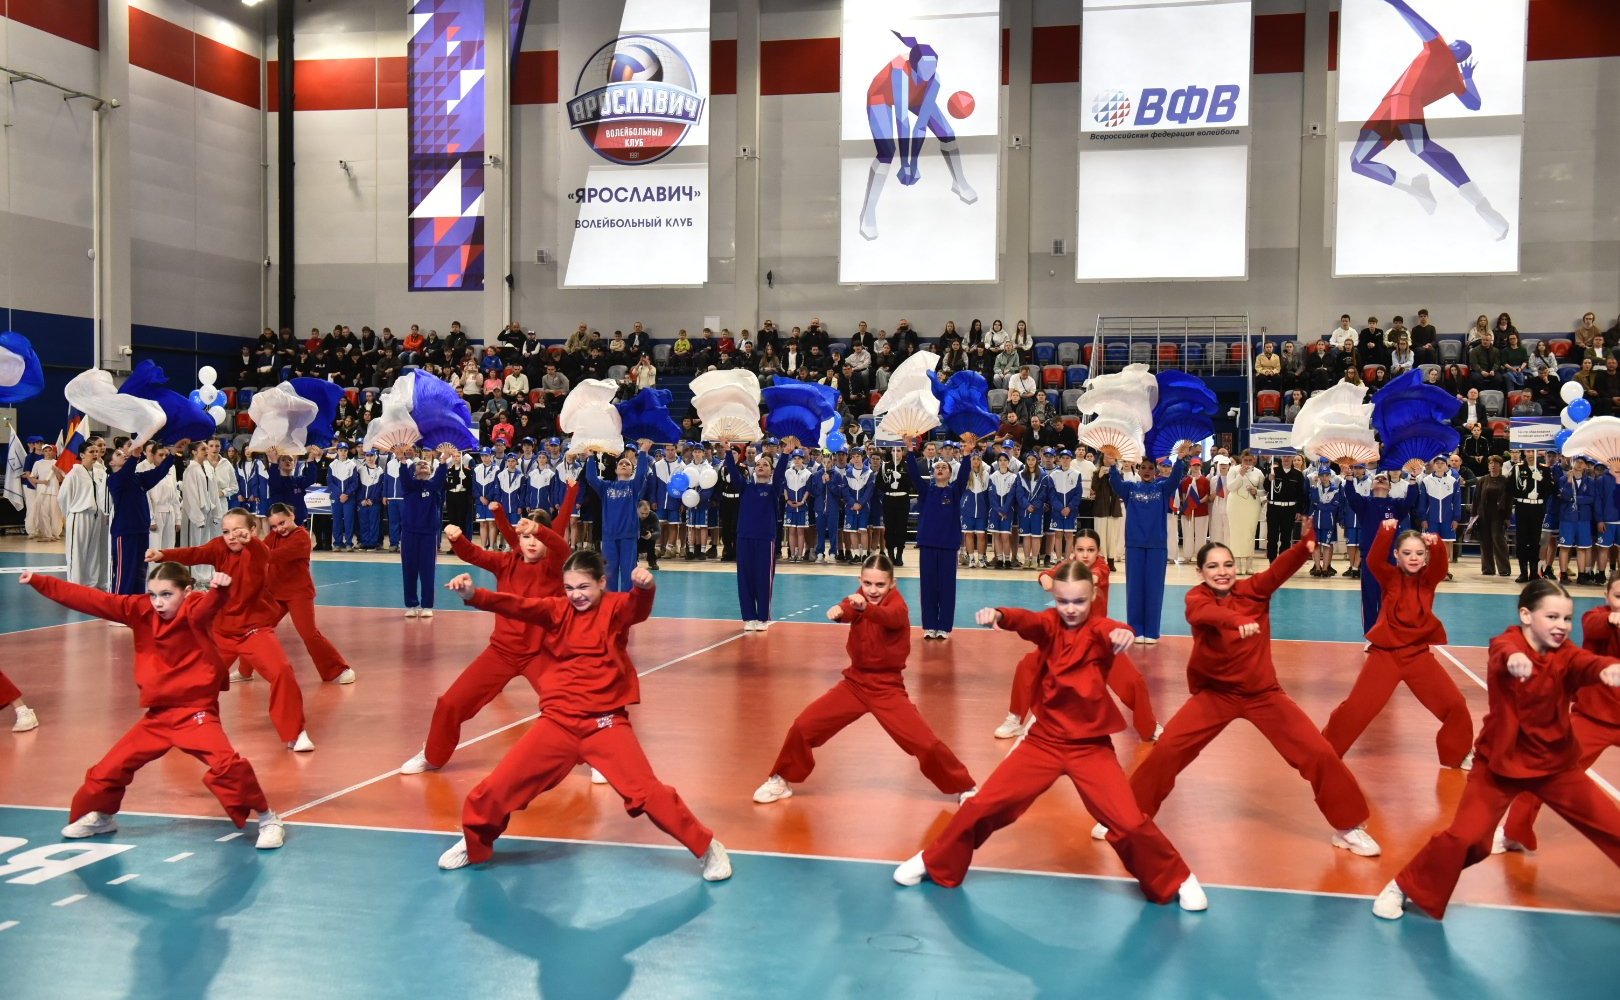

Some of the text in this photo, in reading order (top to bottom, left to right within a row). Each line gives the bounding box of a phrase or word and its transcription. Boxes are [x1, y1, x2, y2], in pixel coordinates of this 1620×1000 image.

[572, 87, 697, 121] ЯРОСЛАВИЧ
[1133, 84, 1241, 126] ВФВ
[605, 126, 663, 139] ВОЛЕЙБОЛЬНЫЙ
[1089, 128, 1240, 141] Всероссийская федерация волейбола
[624, 137, 644, 147] КЛУБ
[567, 185, 701, 204] «ЯРОСЛАВИЧ»
[574, 216, 693, 229] ВОЛЕЙБОЛЬНЫЙ КЛУБ
